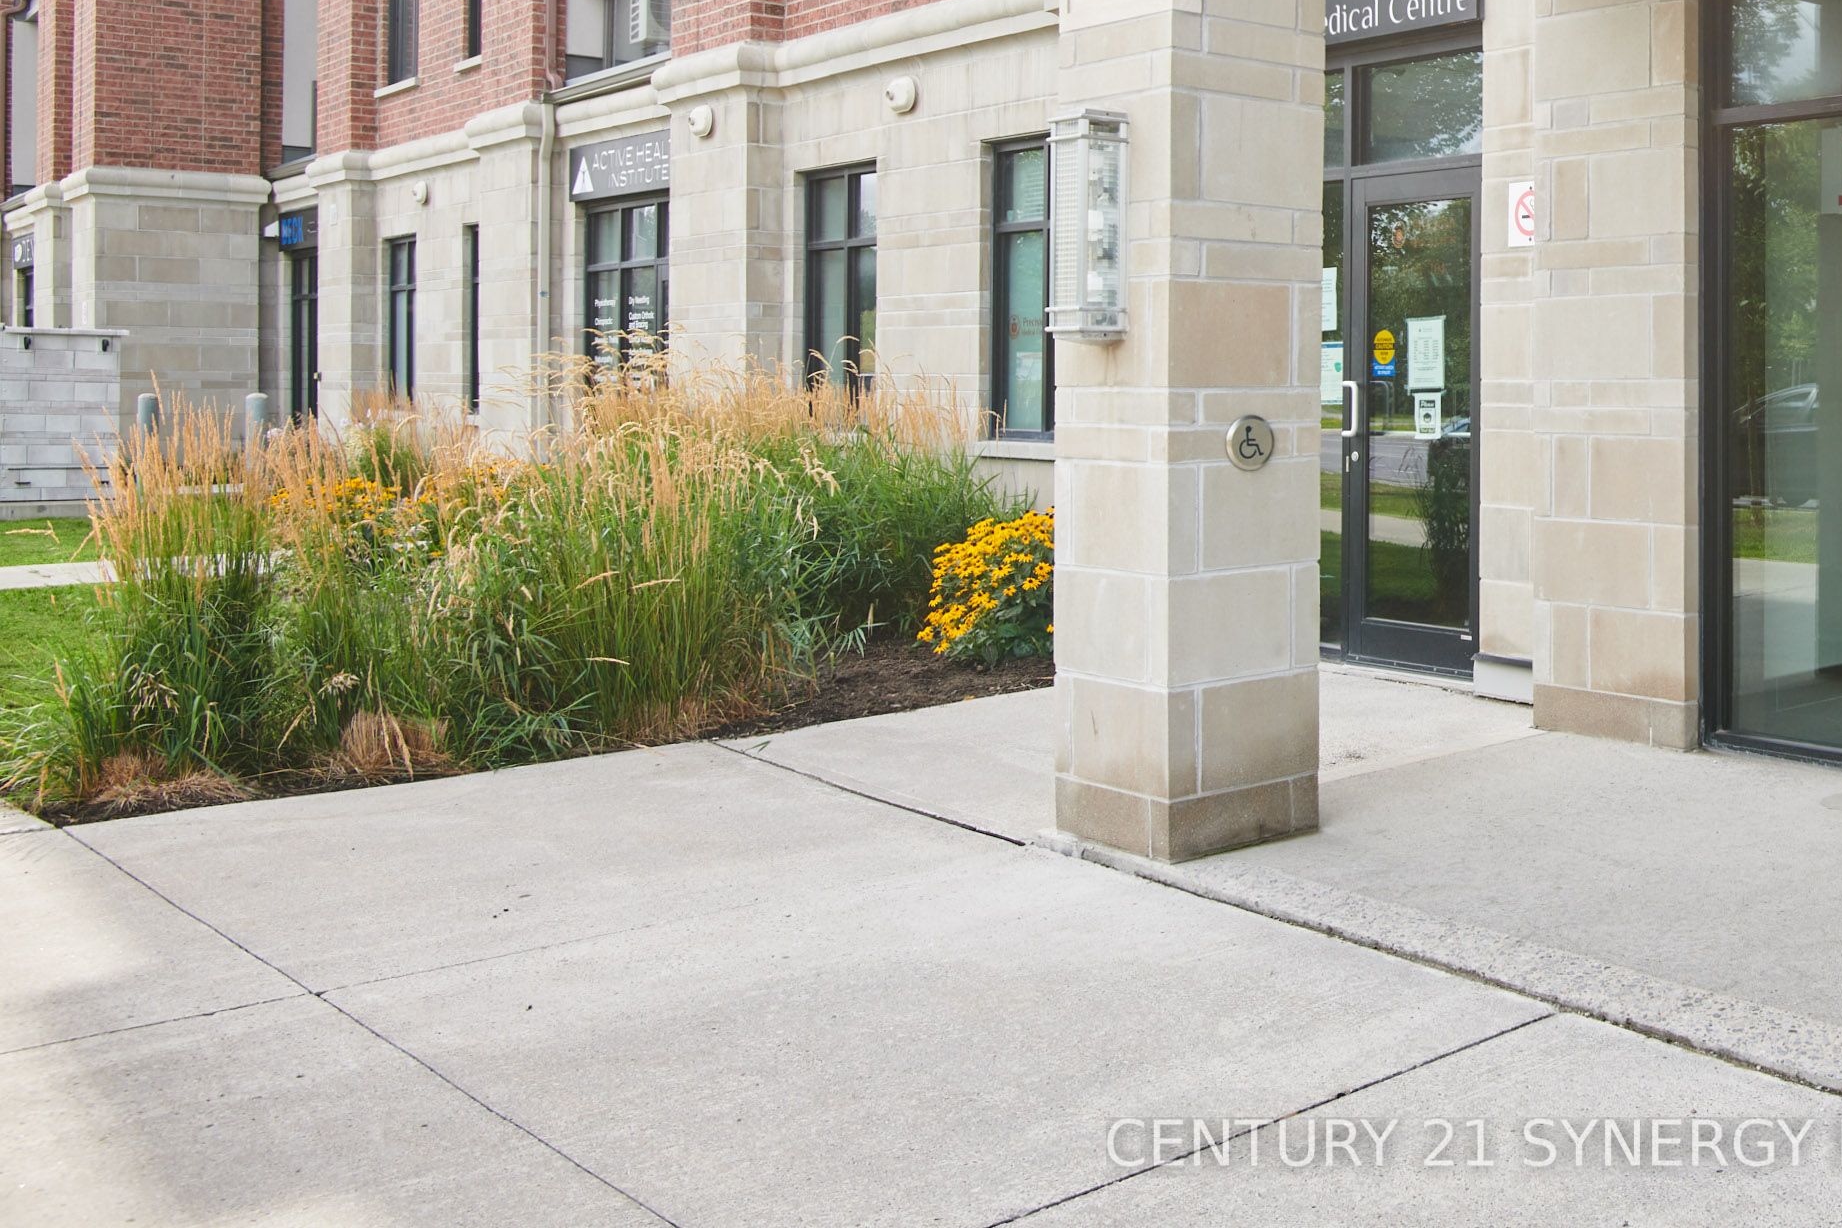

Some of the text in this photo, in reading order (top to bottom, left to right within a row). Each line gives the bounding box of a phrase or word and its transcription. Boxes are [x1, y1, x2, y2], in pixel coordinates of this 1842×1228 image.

[592, 139, 672, 172] ACTIVE HEAL
[608, 164, 669, 188] INSTITUTE
[281, 216, 304, 245] DECK
